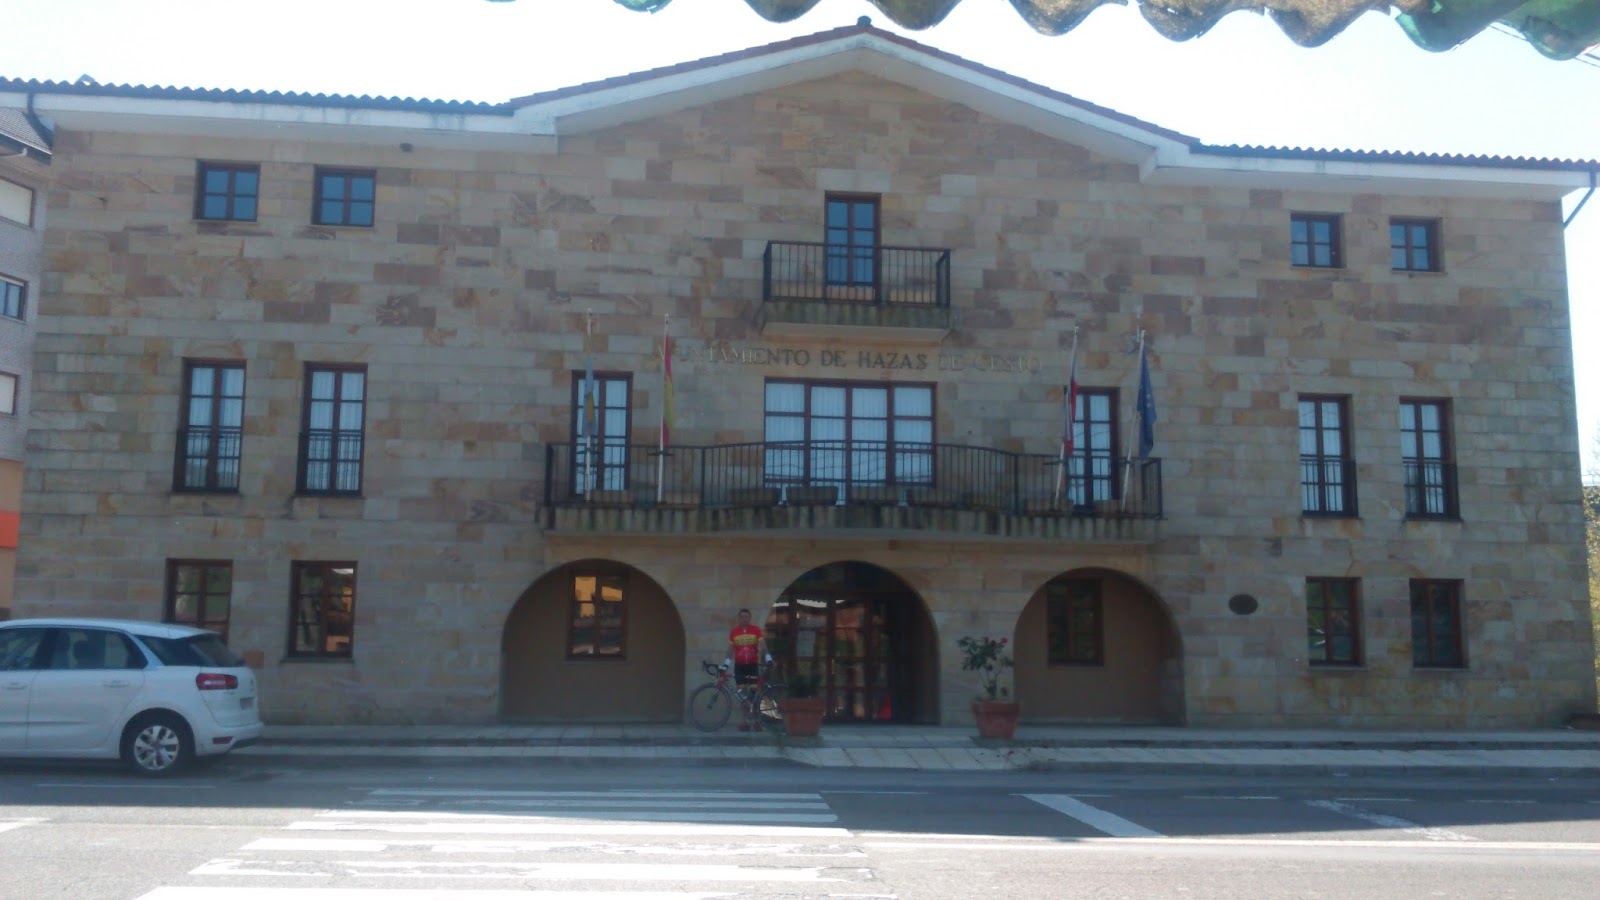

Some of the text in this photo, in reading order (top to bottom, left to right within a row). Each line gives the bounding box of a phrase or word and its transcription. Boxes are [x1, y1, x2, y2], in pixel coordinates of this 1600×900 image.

[655, 345, 1042, 375] AUNTAMIENTO DE HAZAS DE CESTO
